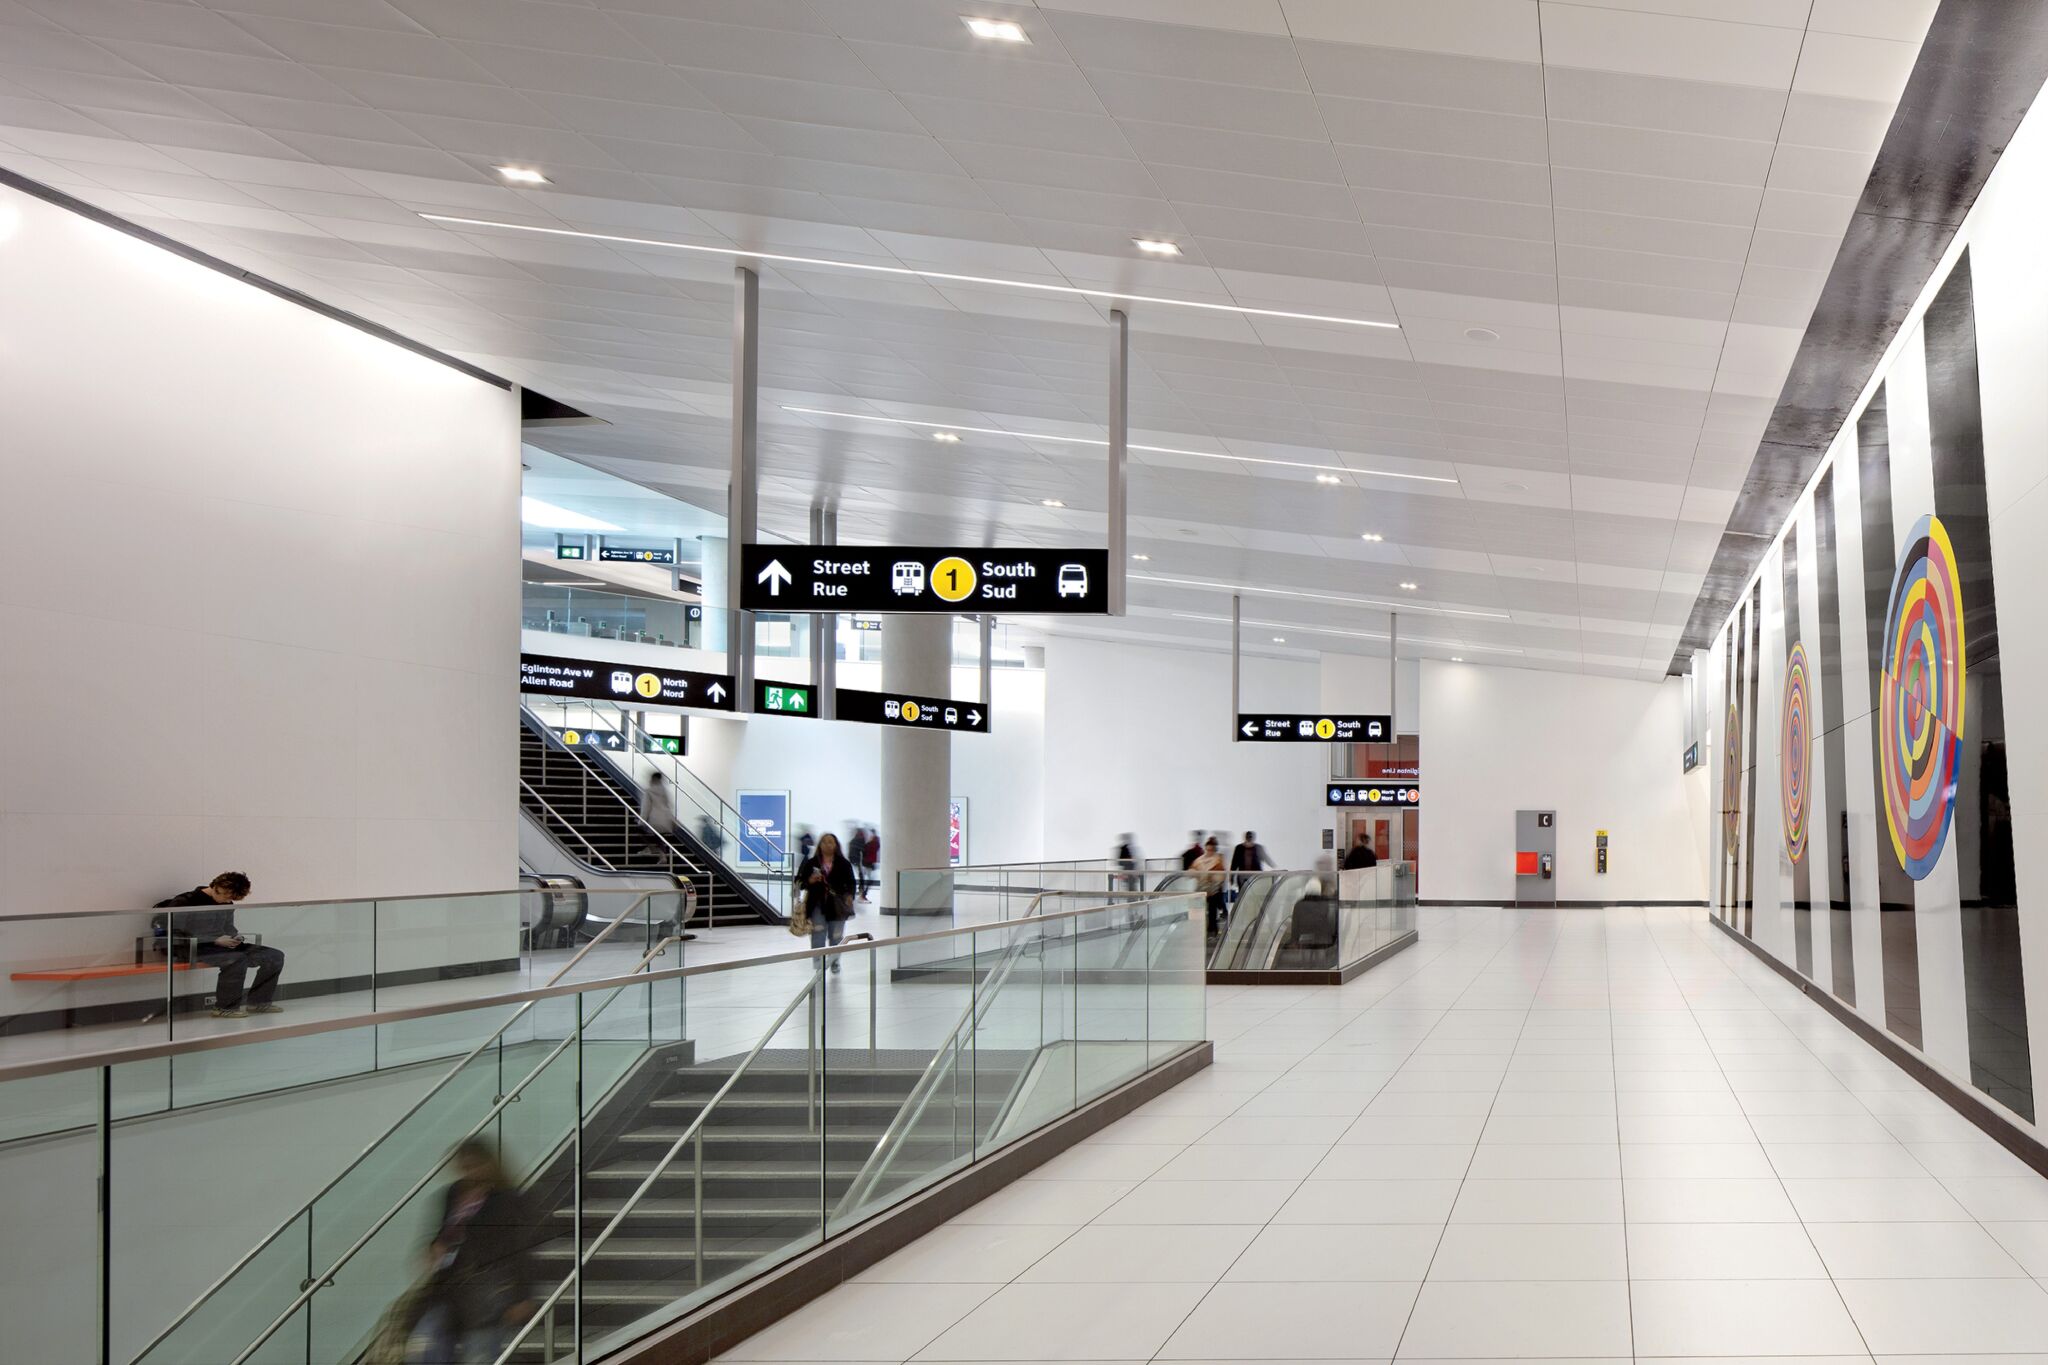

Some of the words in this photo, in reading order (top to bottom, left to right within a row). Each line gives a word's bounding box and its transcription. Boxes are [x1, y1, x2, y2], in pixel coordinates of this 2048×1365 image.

[813, 559, 870, 575] Street
[982, 561, 1036, 578] South
[946, 568, 957, 591] 1
[813, 582, 848, 596] Rue
[982, 584, 1016, 599] Sud
[521, 663, 561, 676] Eglinton
[563, 667, 582, 677] Ave
[583, 669, 593, 678] W
[521, 675, 547, 686] Allen
[549, 677, 574, 688] Road
[663, 678, 688, 688] North
[663, 689, 684, 698] Nord
[921, 705, 939, 713] South
[921, 714, 933, 722] Sud
[1265, 719, 1291, 728] Street
[1337, 720, 1361, 729] South
[1265, 729, 1281, 737] Rue
[1337, 730, 1353, 738] Sud
